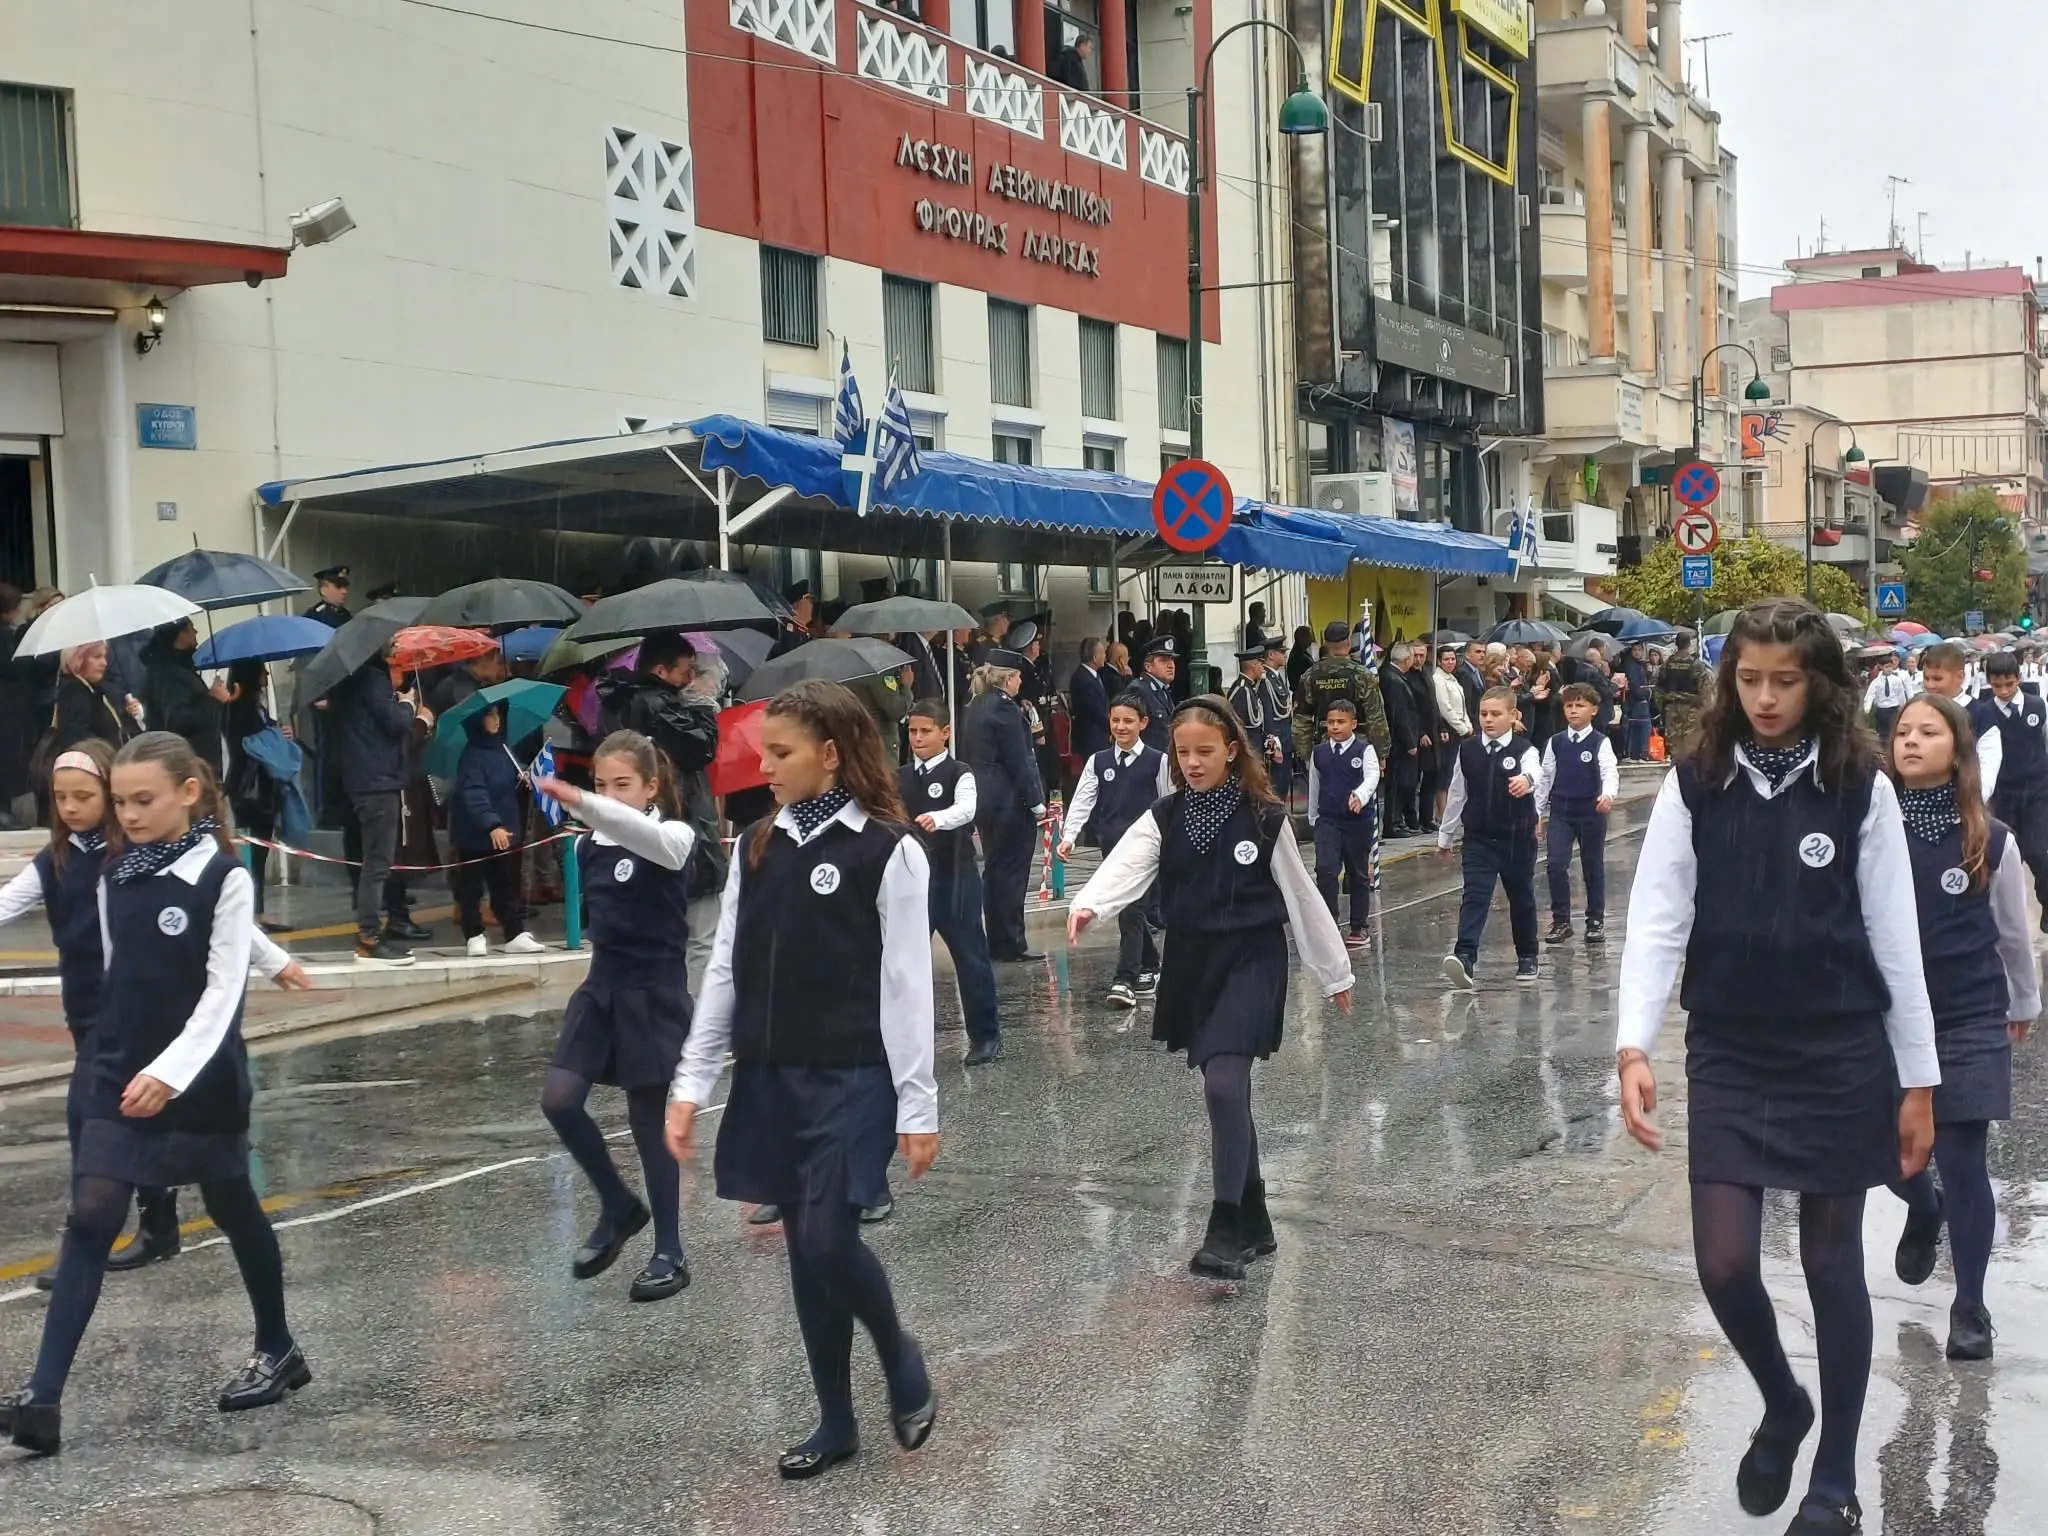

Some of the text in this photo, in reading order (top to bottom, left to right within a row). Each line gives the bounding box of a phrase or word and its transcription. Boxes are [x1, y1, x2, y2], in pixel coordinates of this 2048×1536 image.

[898, 131, 1112, 227] ΛΕΣΧΗ ΑΞΙΩΜΑΤΙΚΩΝ
[916, 198, 1099, 279] ΦΡΟΥΡΑΣ ΛΑΡΙΣΑΣ
[1163, 572, 1183, 580] ΠΛΗΝ
[1315, 677, 1350, 685] MILITARY
[1237, 844, 1255, 862] 24
[1804, 837, 1831, 862] 24
[617, 861, 630, 878] 24
[815, 868, 835, 889] 24
[1946, 872, 1964, 890] 24
[162, 911, 182, 930] 24
